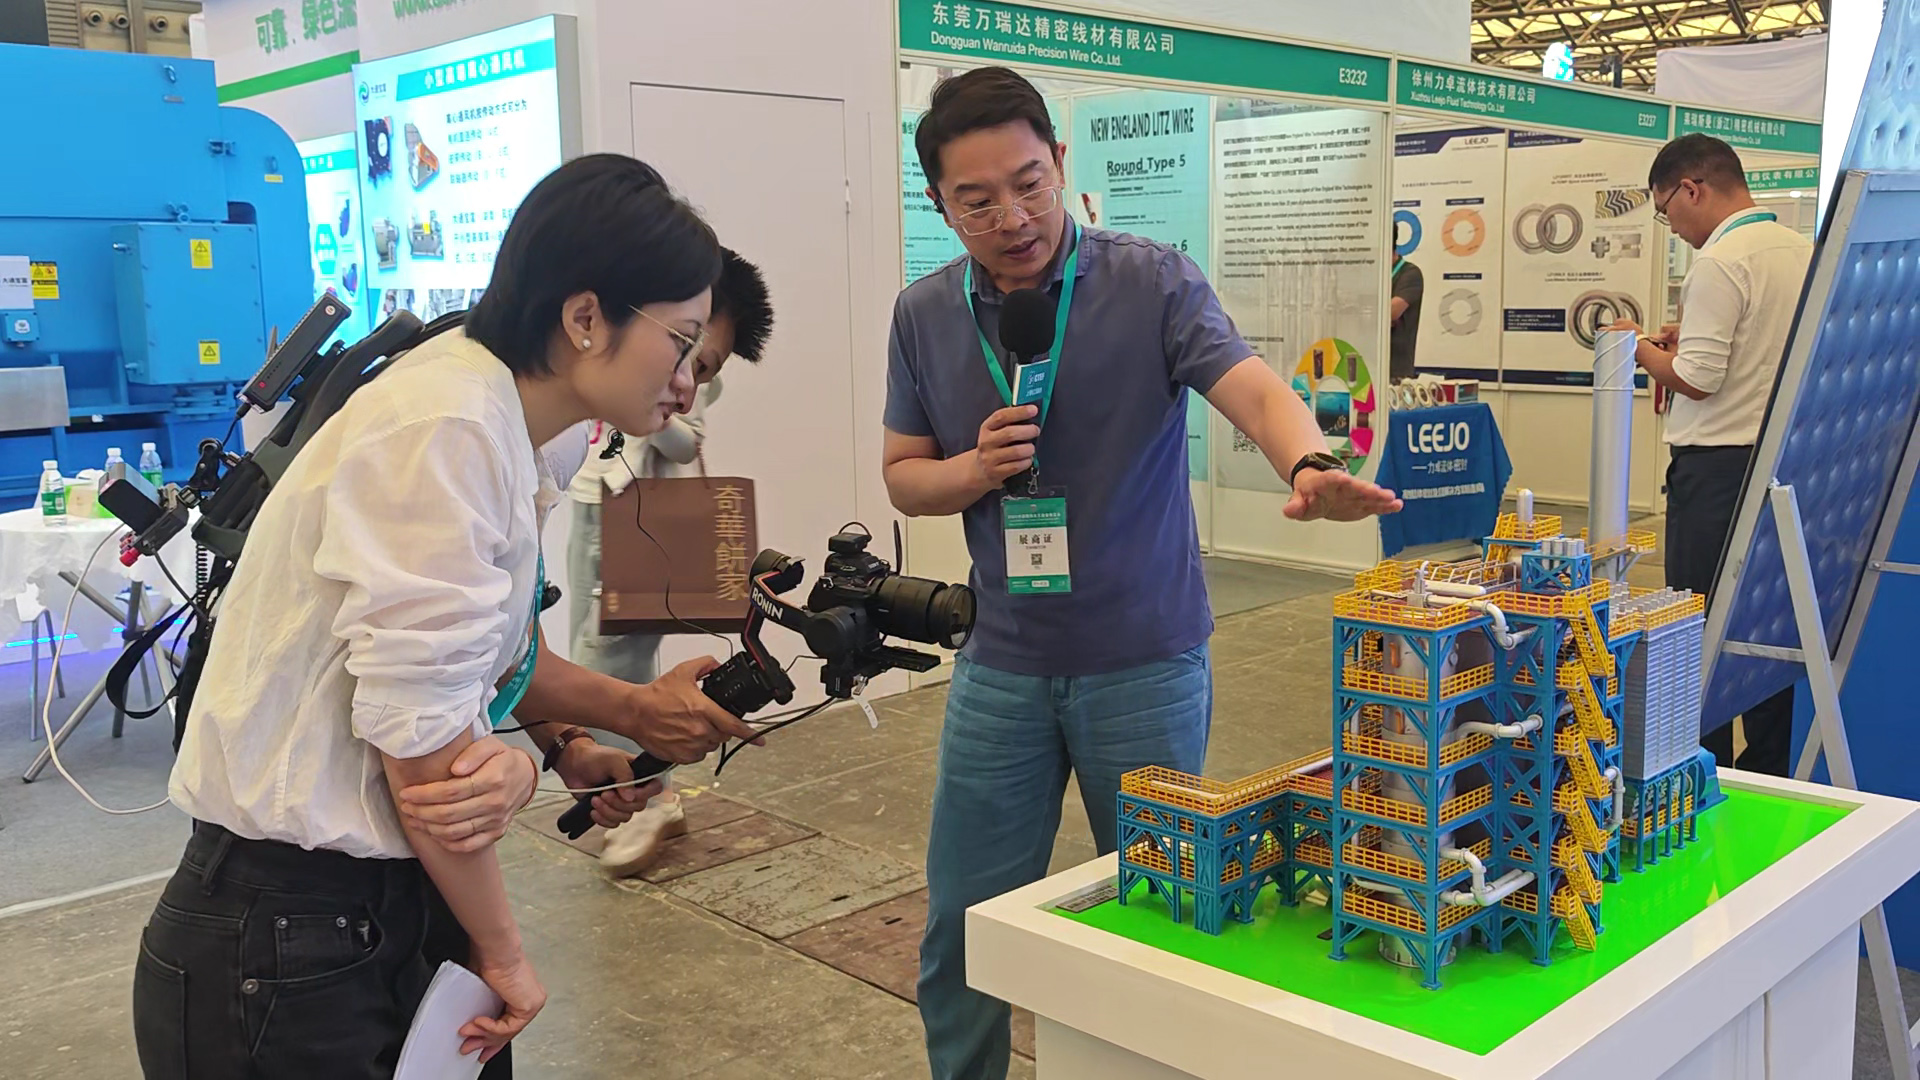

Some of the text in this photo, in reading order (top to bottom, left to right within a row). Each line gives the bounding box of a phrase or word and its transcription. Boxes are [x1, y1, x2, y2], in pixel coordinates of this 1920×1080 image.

[932, 1, 1174, 55] 东莞万瑞达精密线材有限公司
[931, 31, 981, 49] Dongguan
[982, 38, 1027, 55] Wanruida
[1028, 43, 1068, 60] Precision
[1069, 48, 1090, 63] Wire
[1339, 67, 1368, 86] E3232
[1411, 68, 1537, 105] 徐州力卓流体技术有限公司
[1410, 91, 1431, 103] Xuzhou
[1446, 96, 1460, 107] Fluid
[1460, 98, 1487, 112] Technology
[1090, 107, 1195, 143] NEW ENGLAND LITZ WIRE
[1638, 113, 1657, 128] E3237
[1464, 136, 1489, 145] LEEJO
[1106, 154, 1186, 173] Round Type 5
[1180, 239, 1188, 252] 6
[1407, 421, 1470, 454] LEEJO
[714, 484, 748, 601] 奇華餅家
[1019, 533, 1053, 545] 展商证
[752, 587, 784, 621] RONIN
